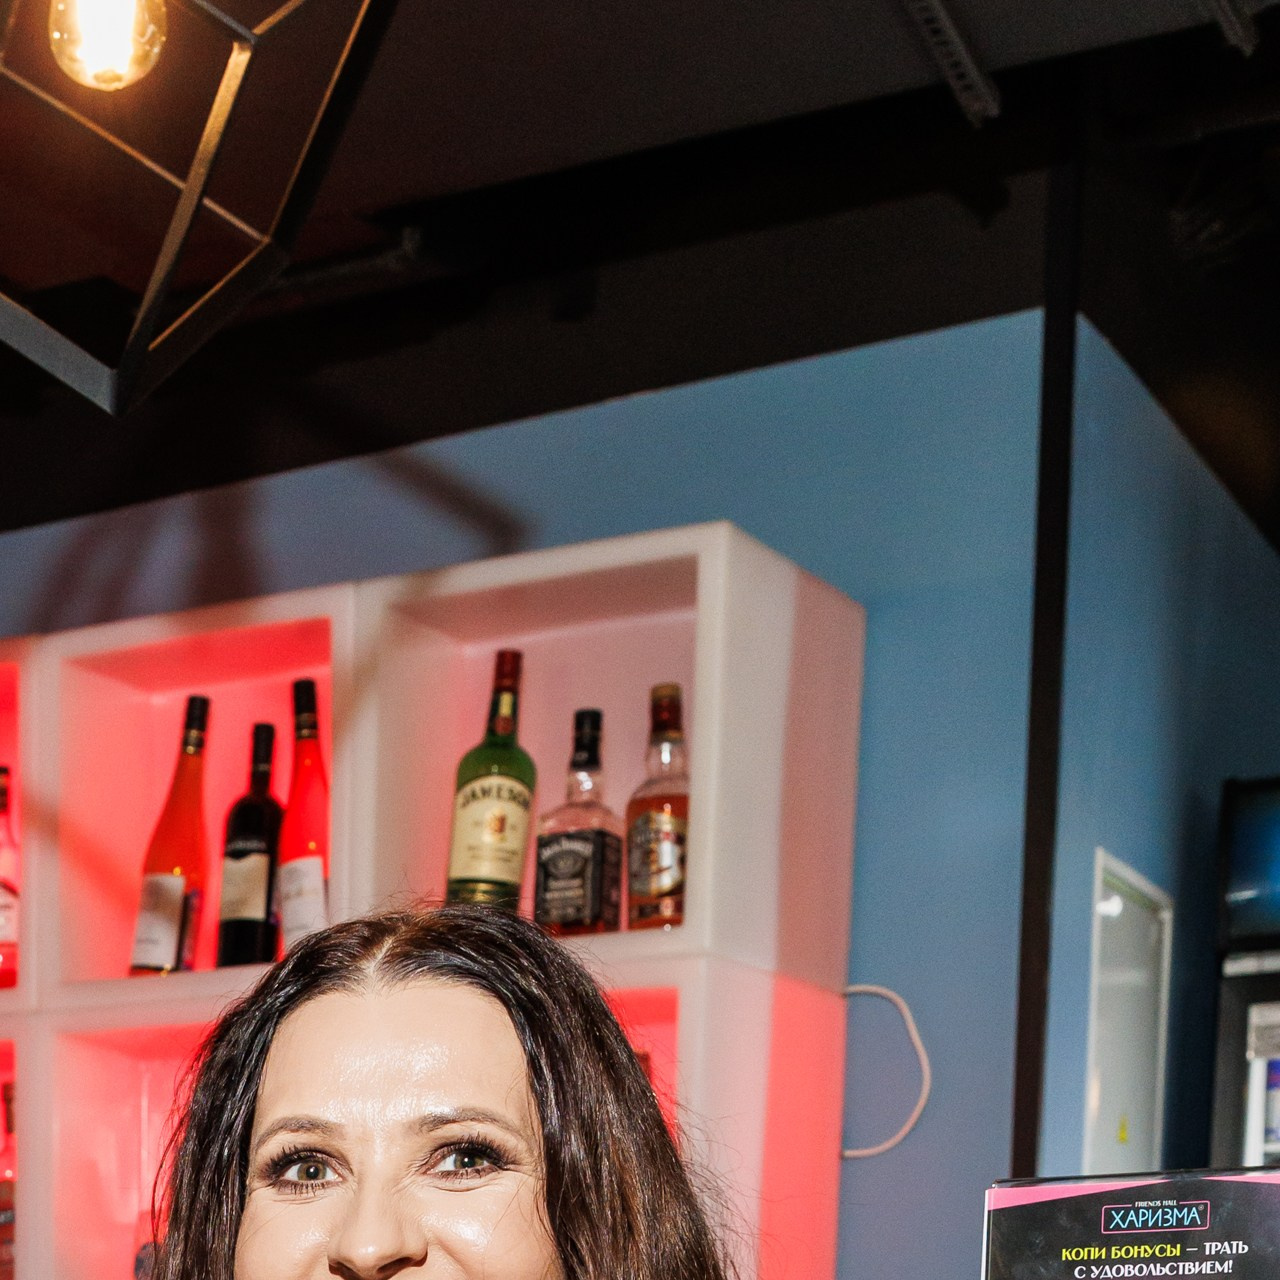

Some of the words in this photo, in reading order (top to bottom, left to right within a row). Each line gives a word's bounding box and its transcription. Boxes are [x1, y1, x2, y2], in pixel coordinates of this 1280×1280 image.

[1134, 1200, 1162, 1208] FRIENDS
[1109, 1206, 1202, 1229] ХАРИЗМА
[1061, 1246, 1107, 1261] КОПИ
[1110, 1243, 1181, 1260] БОНУСЫ
[1203, 1240, 1249, 1255] ТРАТЬ
[1073, 1265, 1086, 1279] С
[1090, 1259, 1233, 1279] УДОВОЛЬСТВИЕМ!
